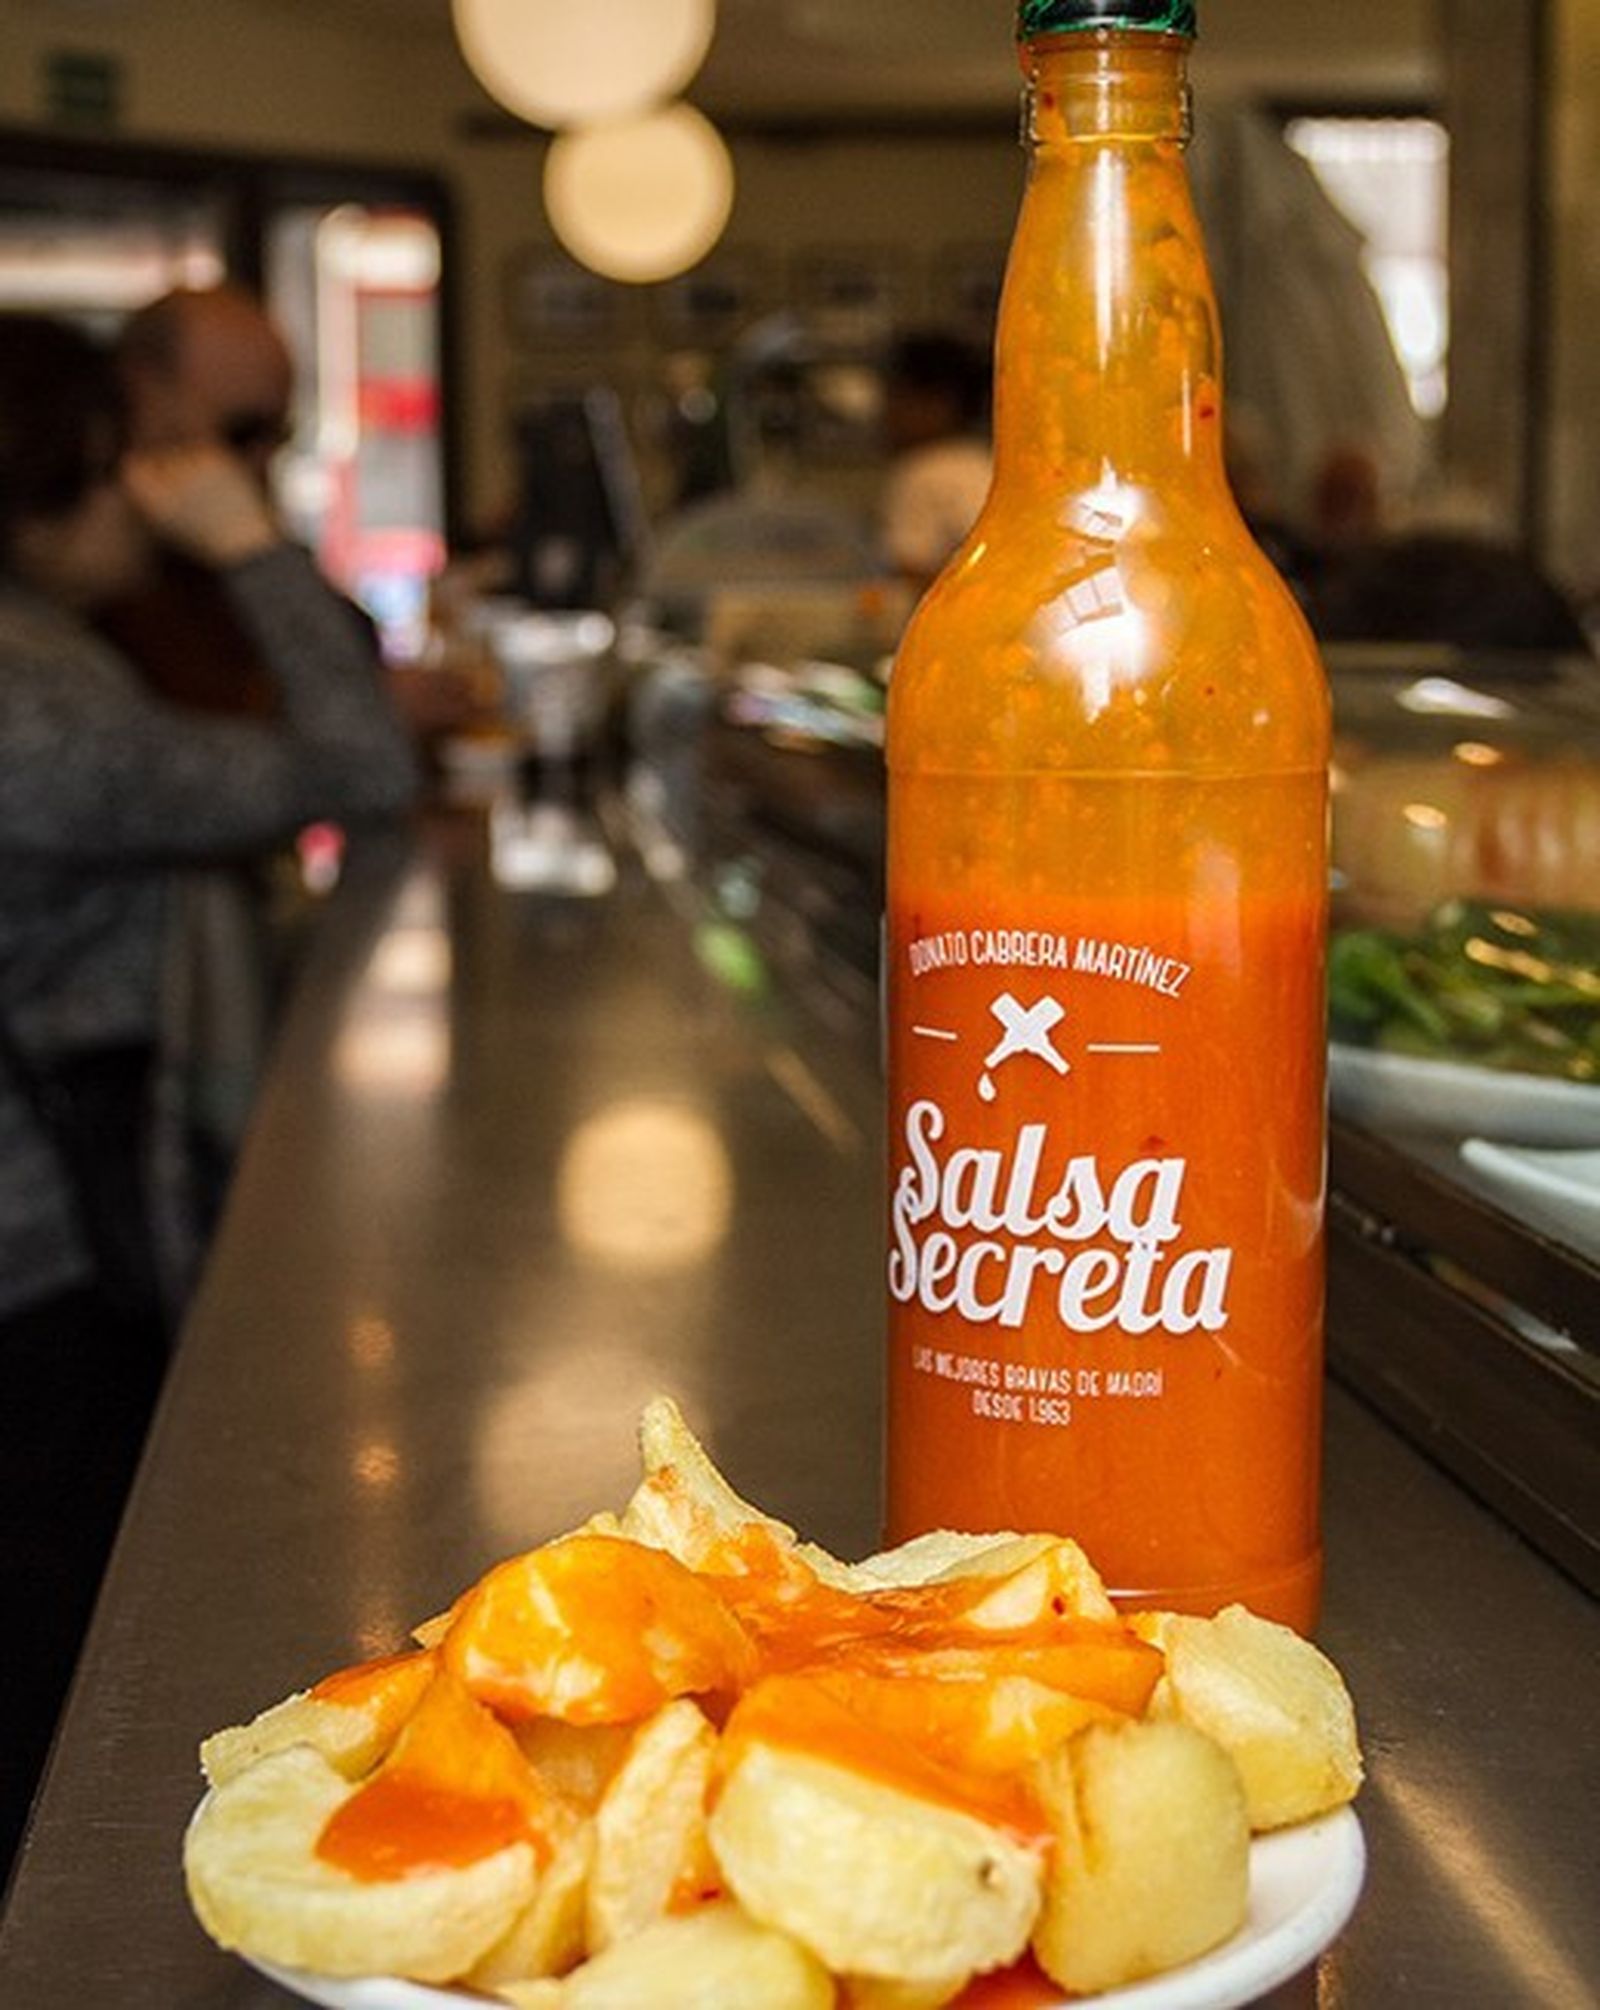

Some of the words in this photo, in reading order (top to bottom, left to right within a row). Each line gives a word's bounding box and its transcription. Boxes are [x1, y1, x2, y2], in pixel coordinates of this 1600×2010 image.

[970, 930, 1068, 969] CABRERA
[1072, 936, 1191, 998] MARTÍNEZ
[897, 1099, 1186, 1242] Salsa
[889, 1166, 1233, 1334] Secreta
[935, 1351, 1000, 1389] MEJORES
[1004, 1364, 1071, 1396] BRAVAS
[1077, 1369, 1099, 1396] DE
[973, 1389, 1023, 1421] DESDE
